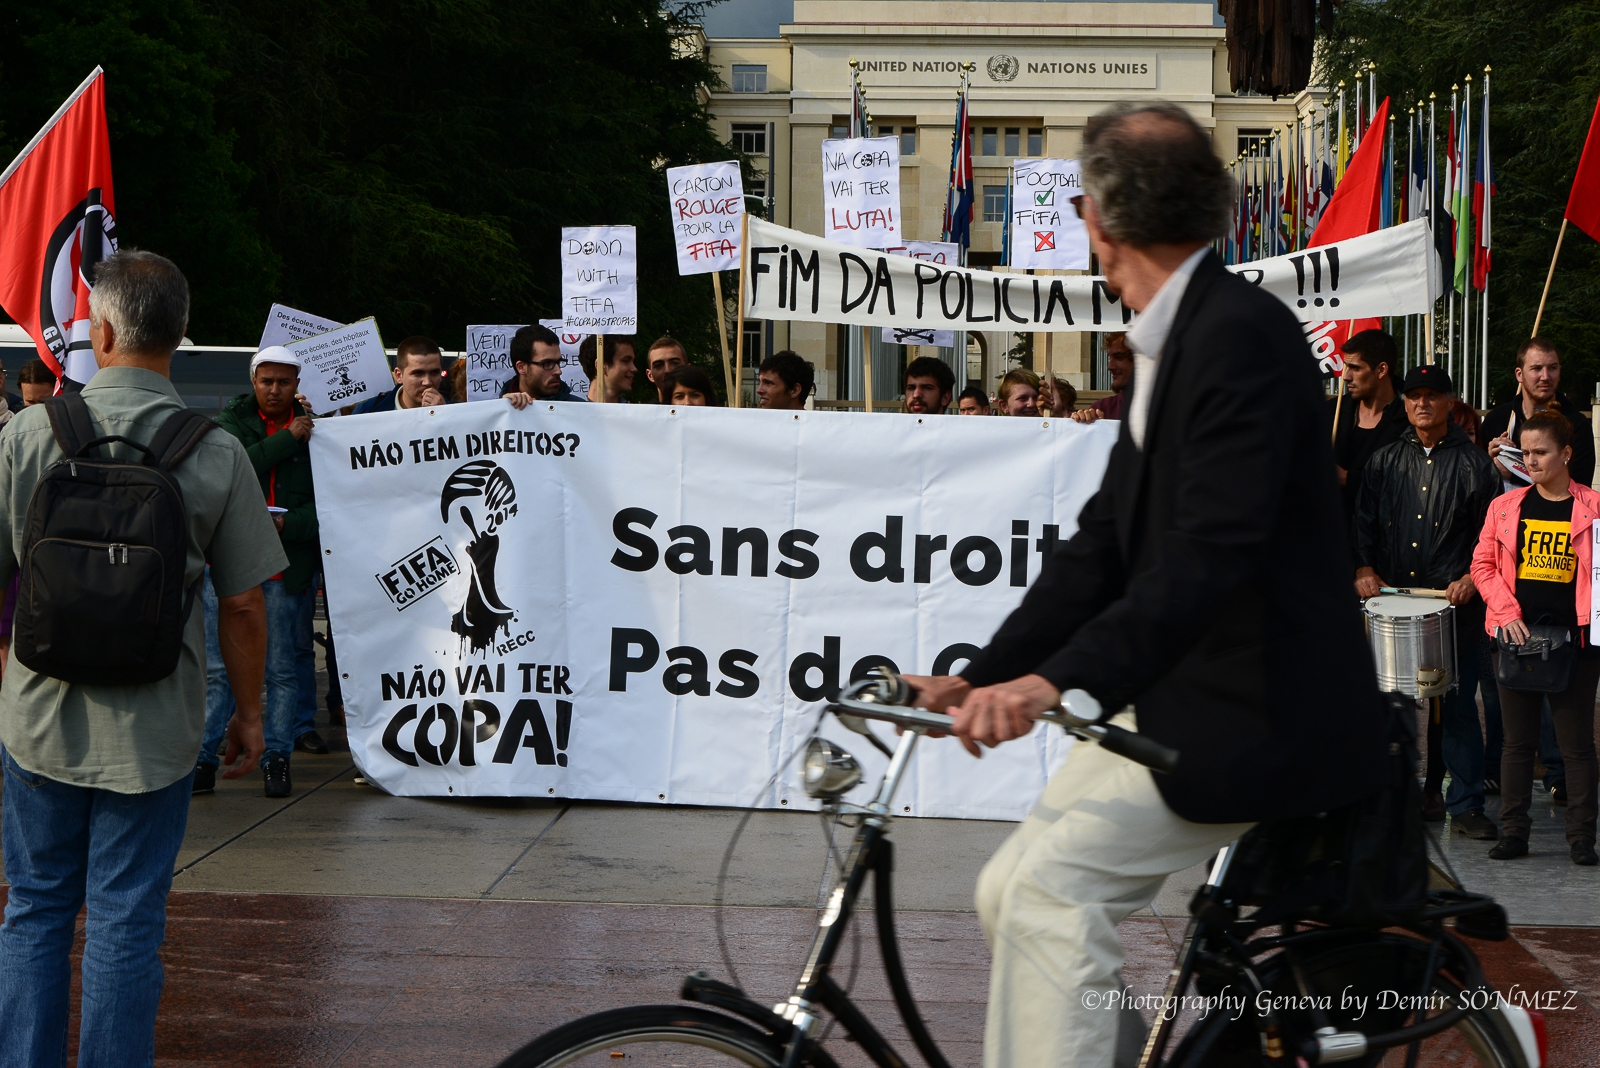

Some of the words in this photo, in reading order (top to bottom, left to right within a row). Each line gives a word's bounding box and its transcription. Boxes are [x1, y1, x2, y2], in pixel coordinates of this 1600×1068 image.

[857, 61, 907, 73] UNITED
[912, 61, 977, 73] NATIONS
[1027, 62, 1097, 74] NATIONS
[1103, 63, 1148, 74] UNIES
[825, 151, 849, 172] NA
[673, 175, 733, 196] CARTON
[858, 180, 890, 195] TER
[1014, 167, 1082, 188] FOOTBAL
[675, 196, 741, 221] ROUGE
[832, 207, 894, 231] LUTA!
[677, 221, 715, 236] POUR
[719, 220, 735, 234] LA
[839, 252, 895, 316] DA
[277, 311, 290, 321] Des
[291, 316, 315, 329] écoles,
[289, 324, 301, 333] des
[302, 328, 318, 337] tran
[564, 315, 636, 327] #COPADASTROPAS
[294, 349, 308, 358] Des
[309, 342, 330, 353] écoles,
[331, 338, 343, 346] des
[343, 330, 370, 342] hôpitaux
[311, 354, 322, 362] des
[323, 344, 354, 358] transports
[354, 340, 367, 348] aux
[471, 332, 506, 352] VEM
[329, 385, 367, 401] COPA!
[469, 379, 492, 393] DE
[350, 439, 403, 470] NÃO
[409, 436, 460, 464] TEM
[465, 429, 581, 458] DIREITOS?
[486, 503, 518, 533] 2014
[610, 506, 820, 579] Sans
[849, 515, 1068, 588] droit
[1527, 530, 1575, 557] FREE
[381, 545, 451, 596] FIFA
[1526, 555, 1574, 571] ASSANGE
[396, 587, 415, 605] GO
[415, 562, 457, 592] HOME
[496, 630, 536, 657] RECC
[608, 627, 760, 699] Pas
[381, 664, 446, 701] NÃO
[454, 663, 505, 695] VAI
[517, 663, 573, 695] TER
[381, 699, 573, 767] COPA!
